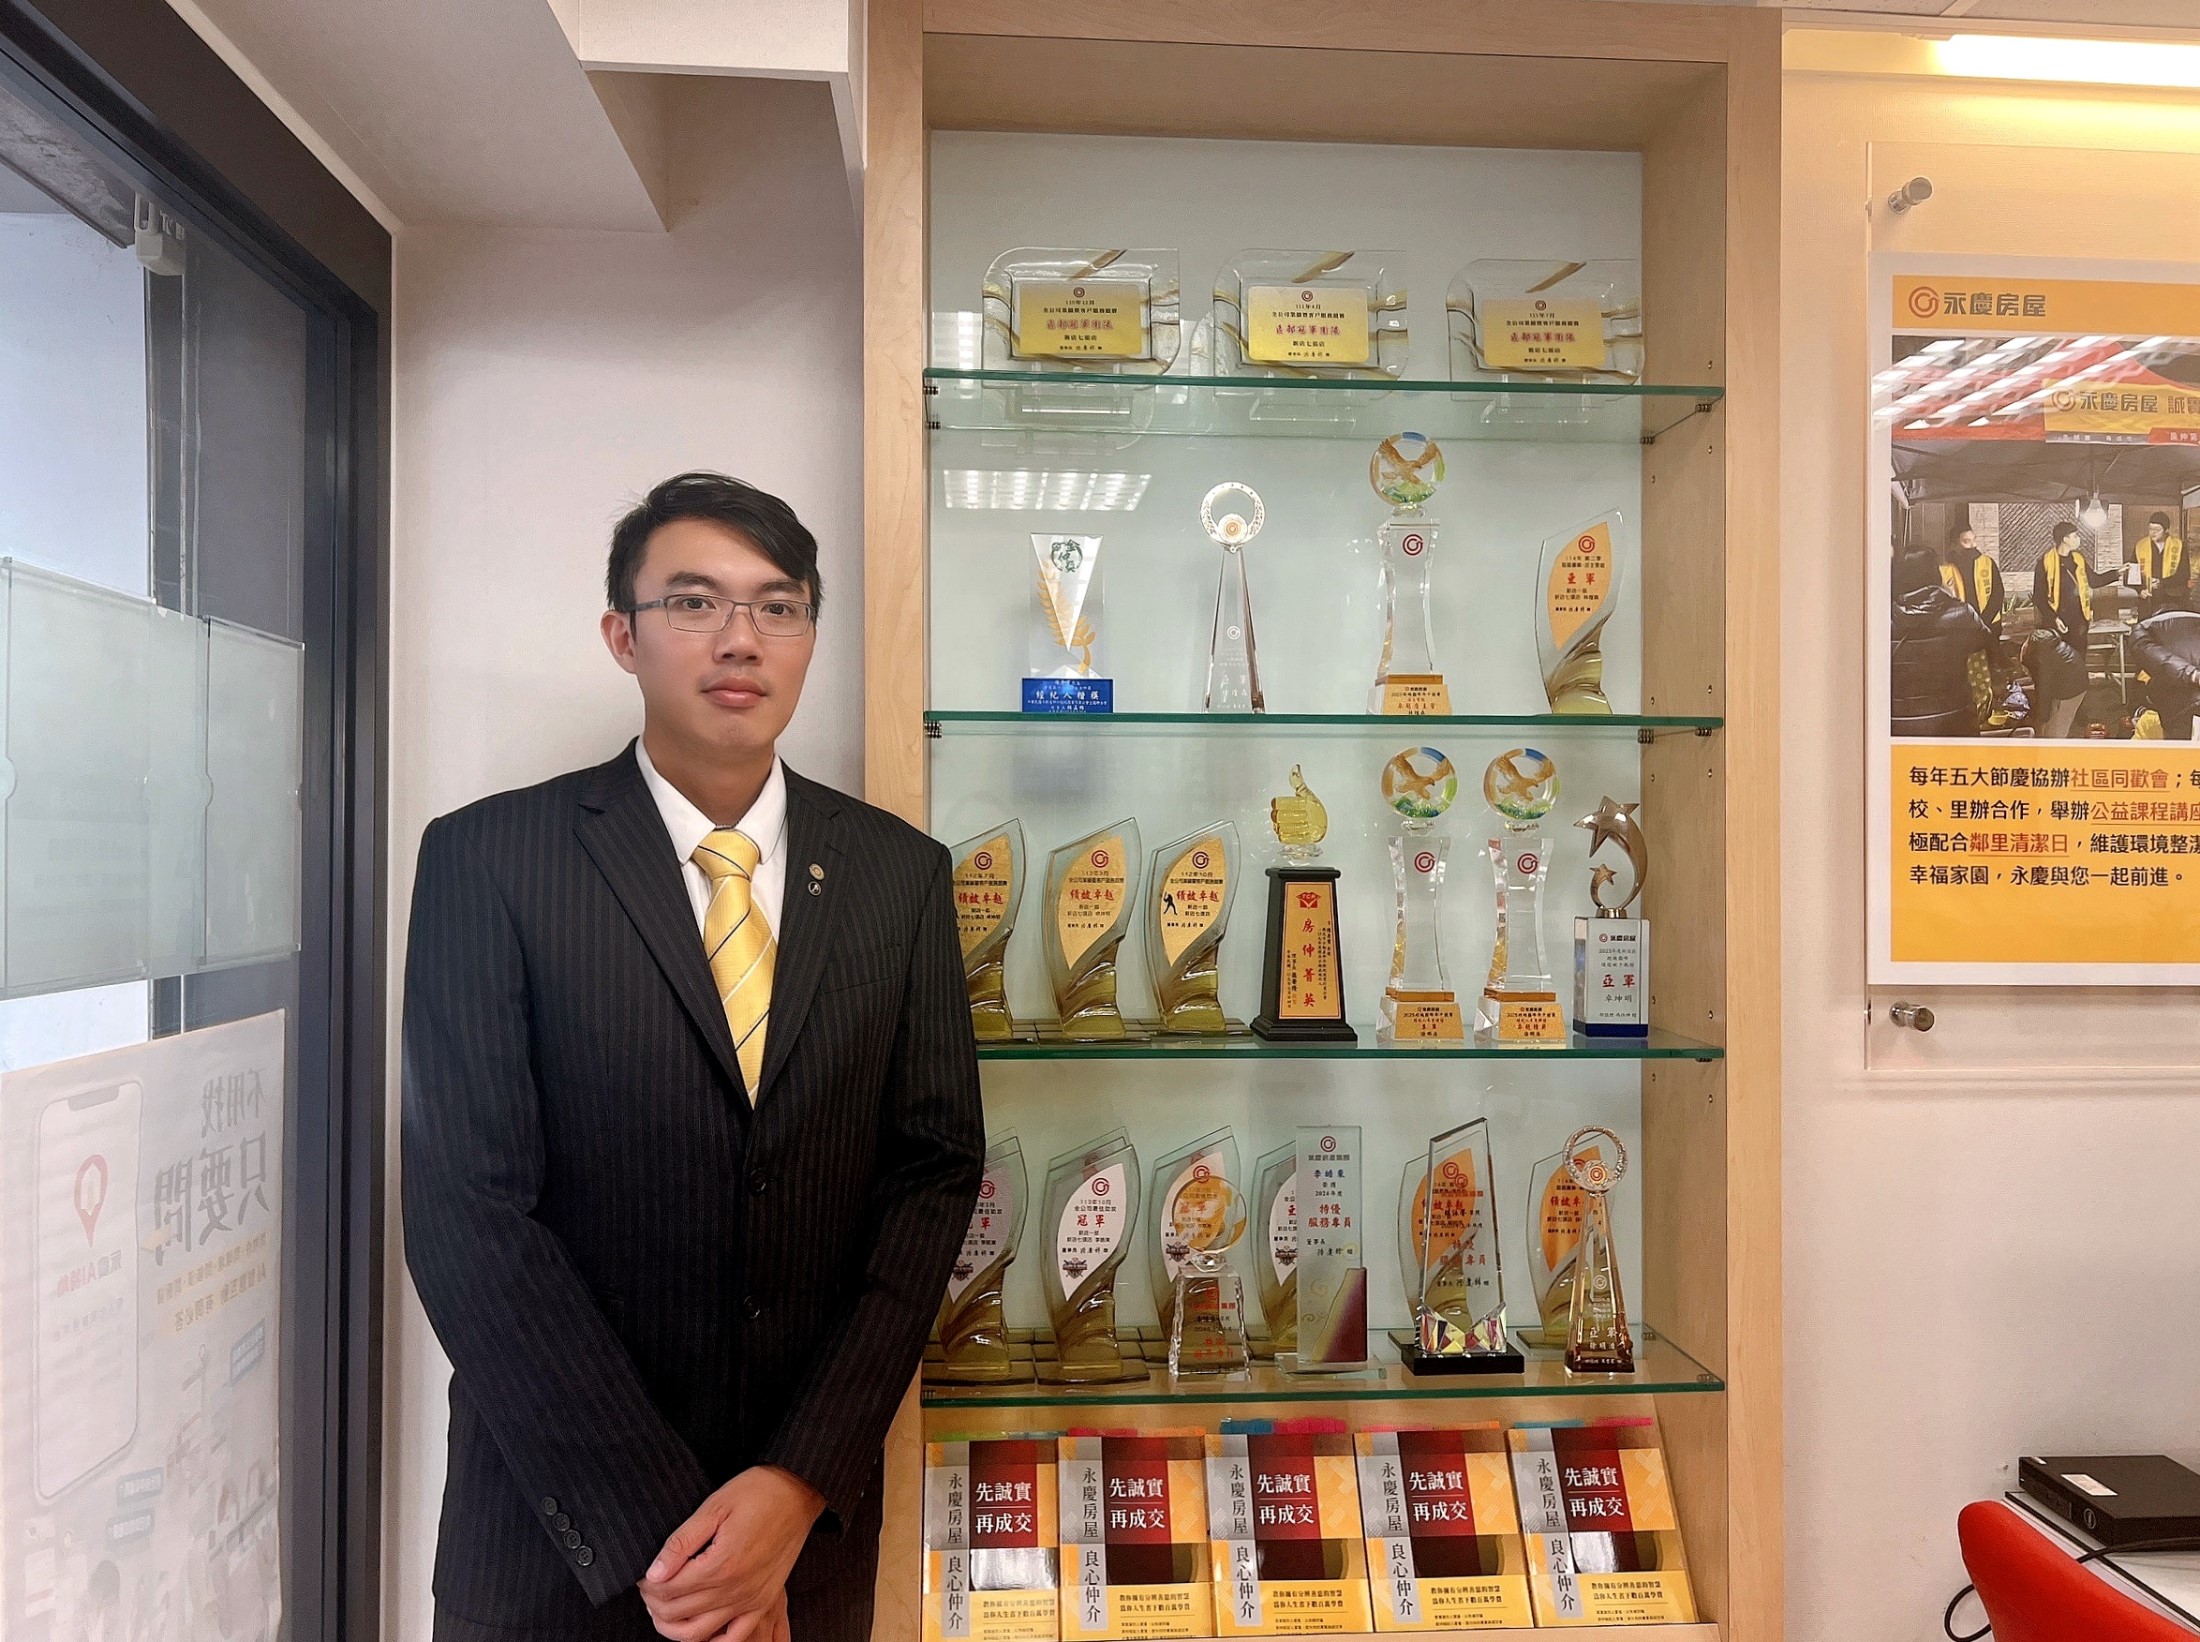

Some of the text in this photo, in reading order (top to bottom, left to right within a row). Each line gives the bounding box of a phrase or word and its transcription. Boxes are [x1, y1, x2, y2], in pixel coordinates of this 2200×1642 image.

[1943, 292, 2046, 317] 永慶房屋
[2080, 391, 2158, 413] 永慶房屋
[1036, 690, 1099, 700] 經紀人楷模
[1909, 865, 2183, 887] 幸福家園，永慶與您一起前進。
[958, 892, 1004, 905] 績效卓越
[1070, 889, 1115, 901] 績效卓越
[1176, 890, 1219, 903] 績效卓越
[1302, 918, 1316, 1008] 房仲菁英
[1602, 974, 1636, 988] 亞軍
[1319, 1203, 1341, 1215] 特優
[1077, 1214, 1105, 1228] 冠軍
[1308, 1216, 1351, 1228] 服務專員
[1109, 1477, 1164, 1499] 先誠實
[1257, 1472, 1312, 1494] 先誠實
[1408, 1470, 1464, 1492] 先誠實
[1564, 1466, 1619, 1488] 先誠實
[975, 1481, 1032, 1503] 先誠實
[1110, 1507, 1165, 1529] 再成交
[1258, 1503, 1315, 1525] 再成交
[1412, 1500, 1469, 1522] 再成交
[1569, 1496, 1625, 1518] 再成交
[975, 1512, 1032, 1534] 再成交
[1082, 1467, 1101, 1624] 永慶房屋 良心仲介
[1229, 1463, 1255, 1620] 永慶房屋 良心仲介
[1380, 1460, 1414, 1616] 永慶房屋 良心仲介
[1536, 1457, 1575, 1612] 永慶房屋 良心仲介
[947, 1472, 964, 1631] 永慶房屋 良心仲介
